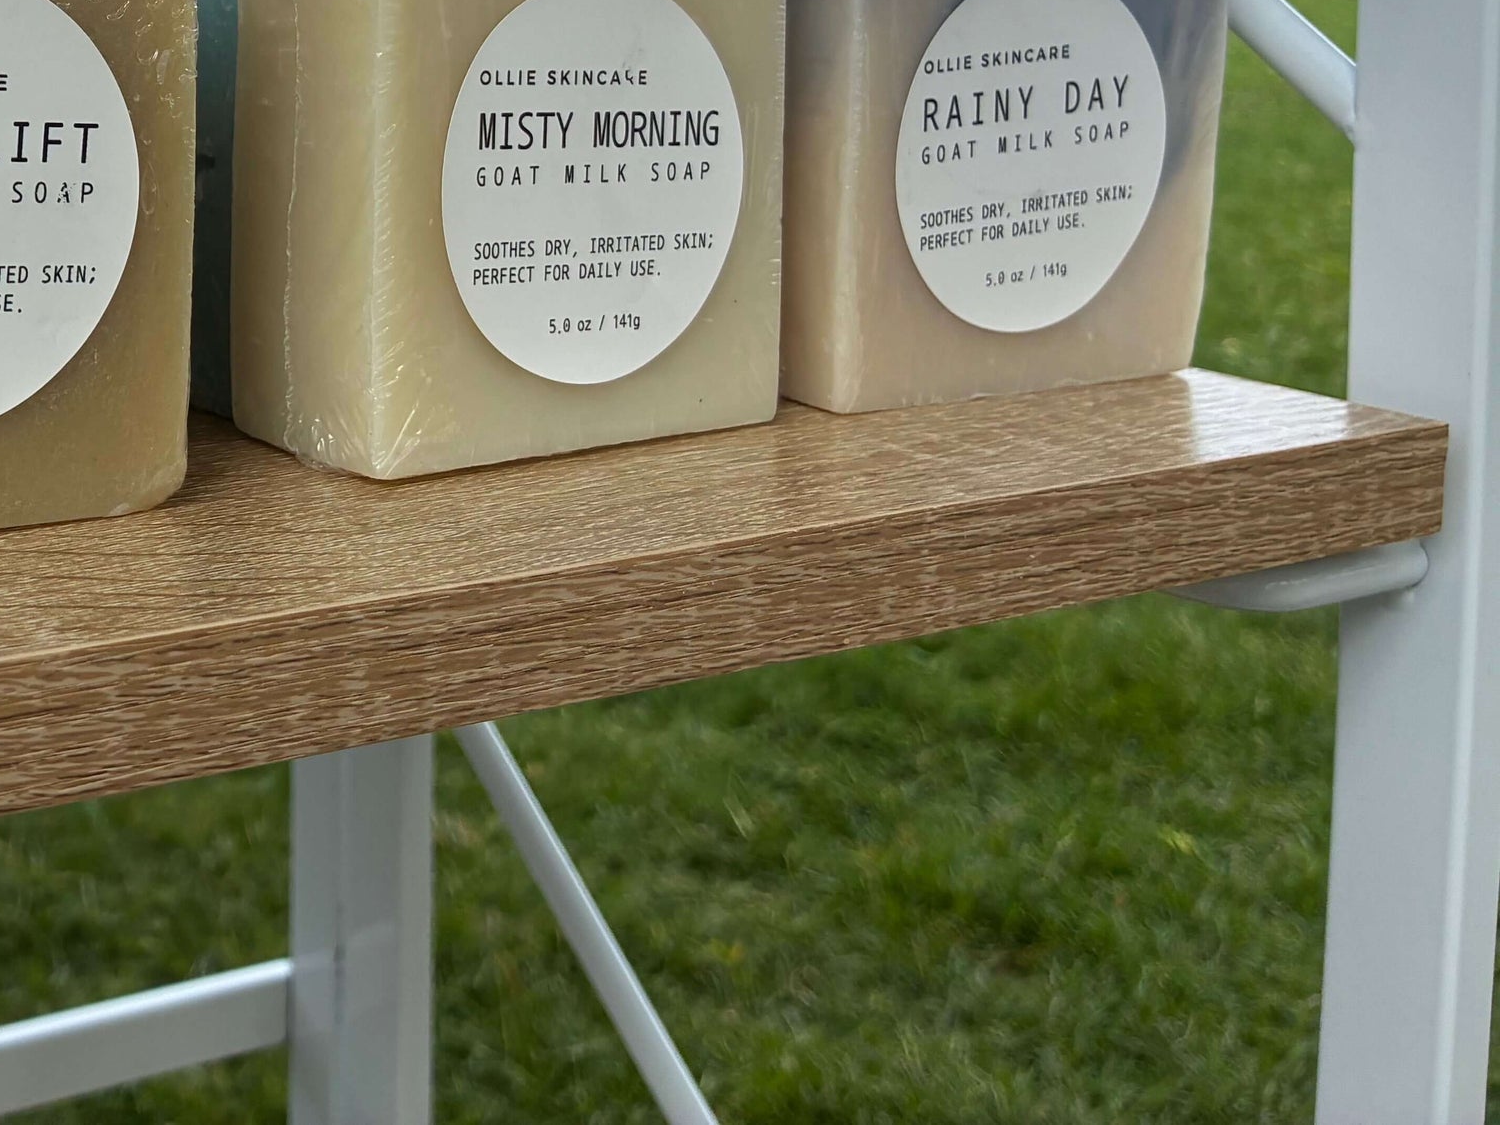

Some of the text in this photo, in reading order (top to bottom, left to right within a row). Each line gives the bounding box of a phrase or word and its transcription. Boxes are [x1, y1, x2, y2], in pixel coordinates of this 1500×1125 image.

[923, 43, 1070, 75] OLLIE SKINCARE
[479, 69, 537, 86] OLLIE
[923, 74, 1129, 133] RAINY DAY
[478, 109, 720, 151] MISTY MORNING
[921, 120, 1129, 166] GOAT MILK SOAP
[476, 161, 711, 188] GOAT MILK SOAP
[11, 180, 94, 204] SOAP
[920, 185, 1132, 230] SOOTHES DRY, IRRITATED SKIN;
[920, 212, 1085, 252] PERFECT FOR DAILY USE.
[473, 232, 713, 261] SOOTHES DRY, IRRITATED SKIN;
[41, 264, 96, 285] SKIN;
[472, 259, 661, 286] PERFECT FOR DAILY USE.
[985, 262, 1067, 287] 5.0 oz / 141g
[549, 313, 641, 335] 5.0 oz / 141g
